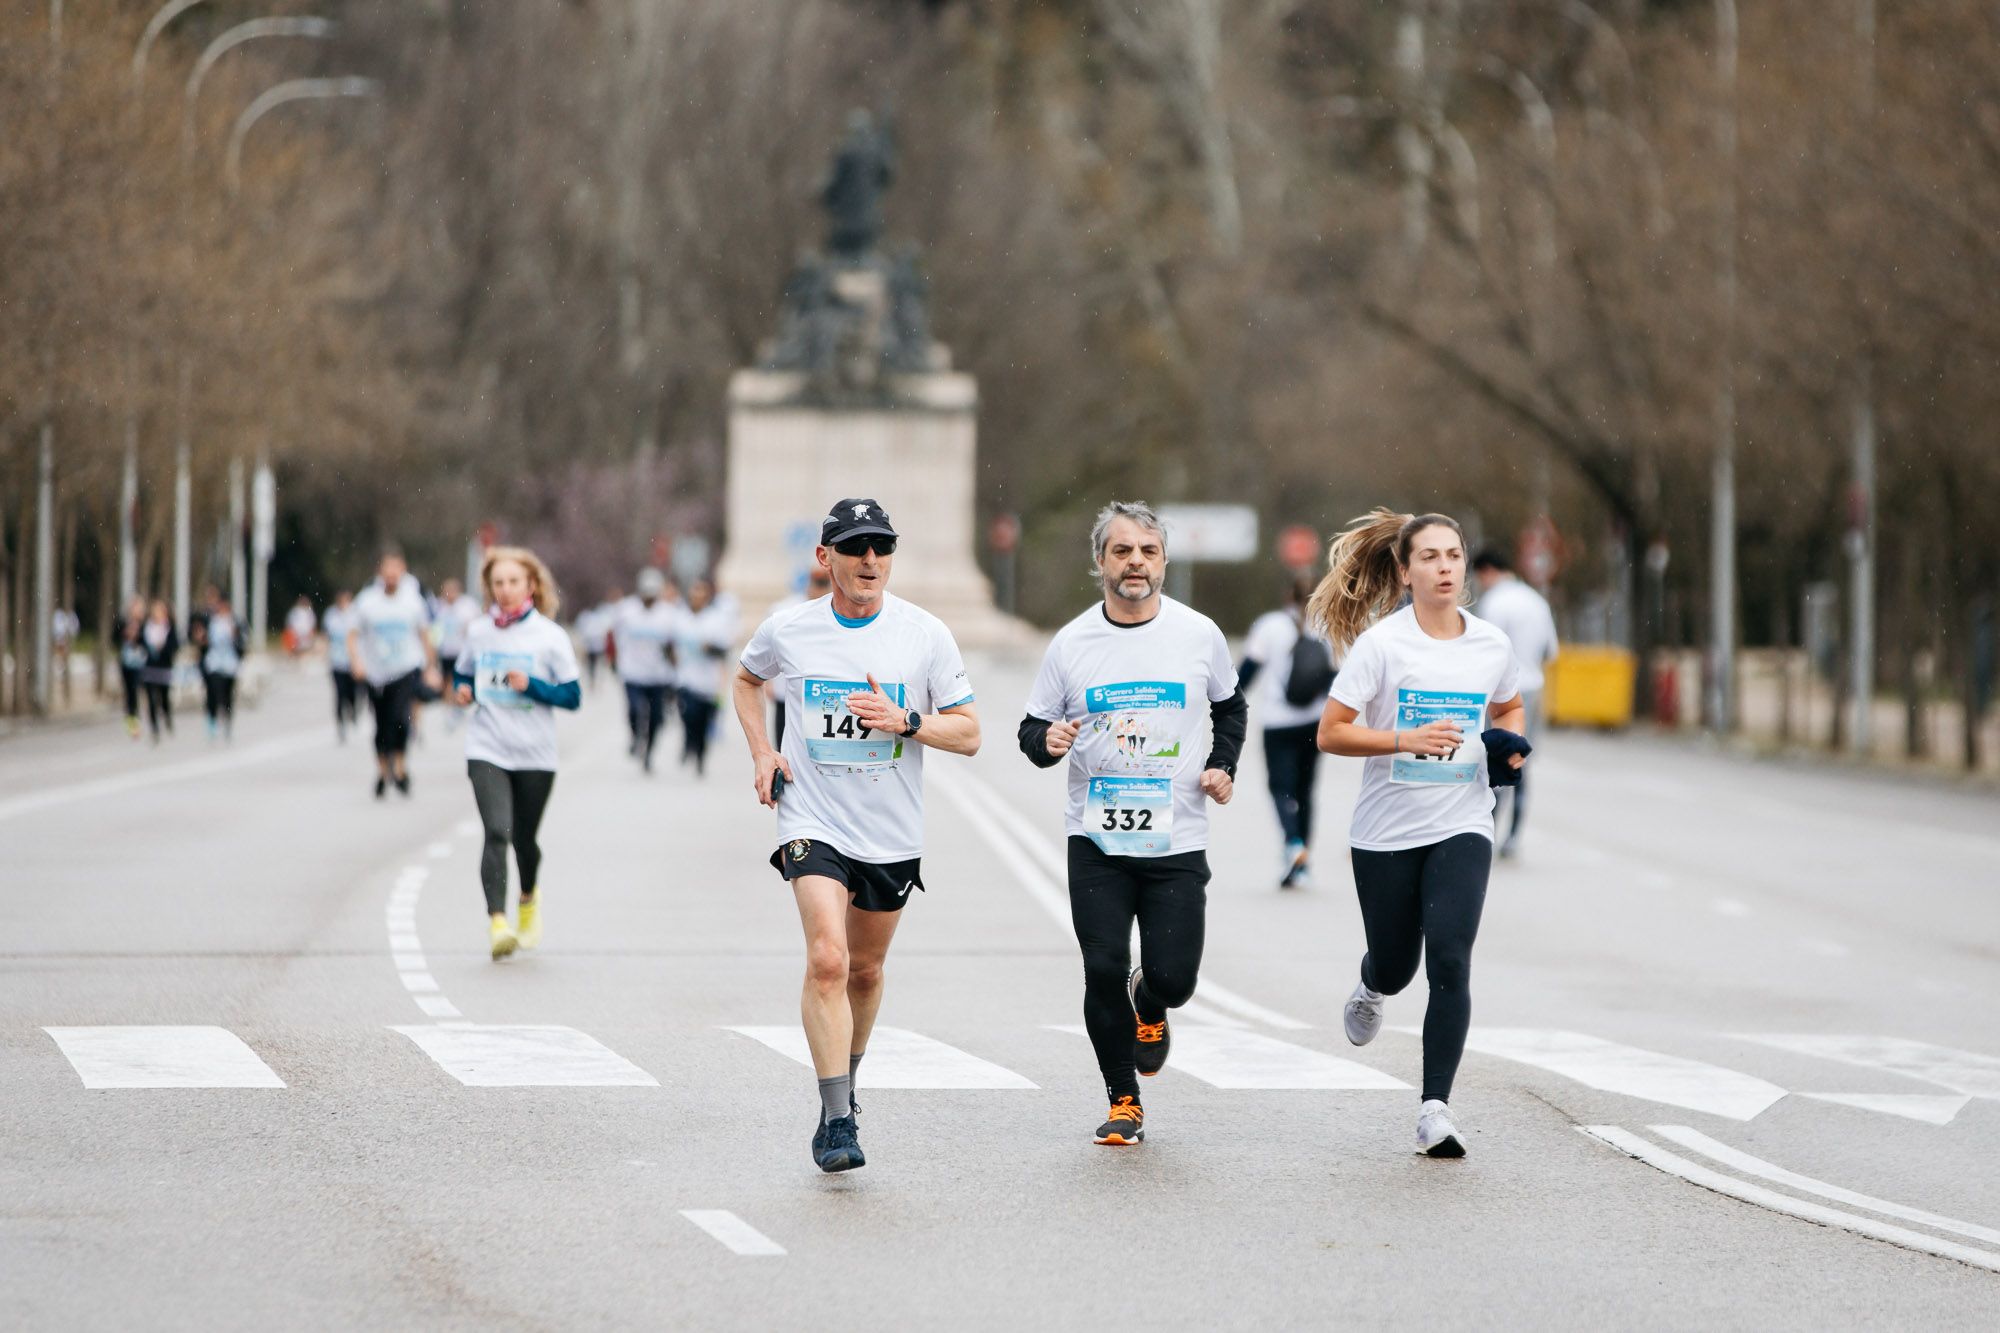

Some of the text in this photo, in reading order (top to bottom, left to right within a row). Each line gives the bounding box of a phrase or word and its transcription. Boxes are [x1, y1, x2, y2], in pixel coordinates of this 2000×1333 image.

[1134, 686, 1167, 694] Solidaria
[822, 714, 872, 739] 149
[1102, 809, 1152, 831] 332
